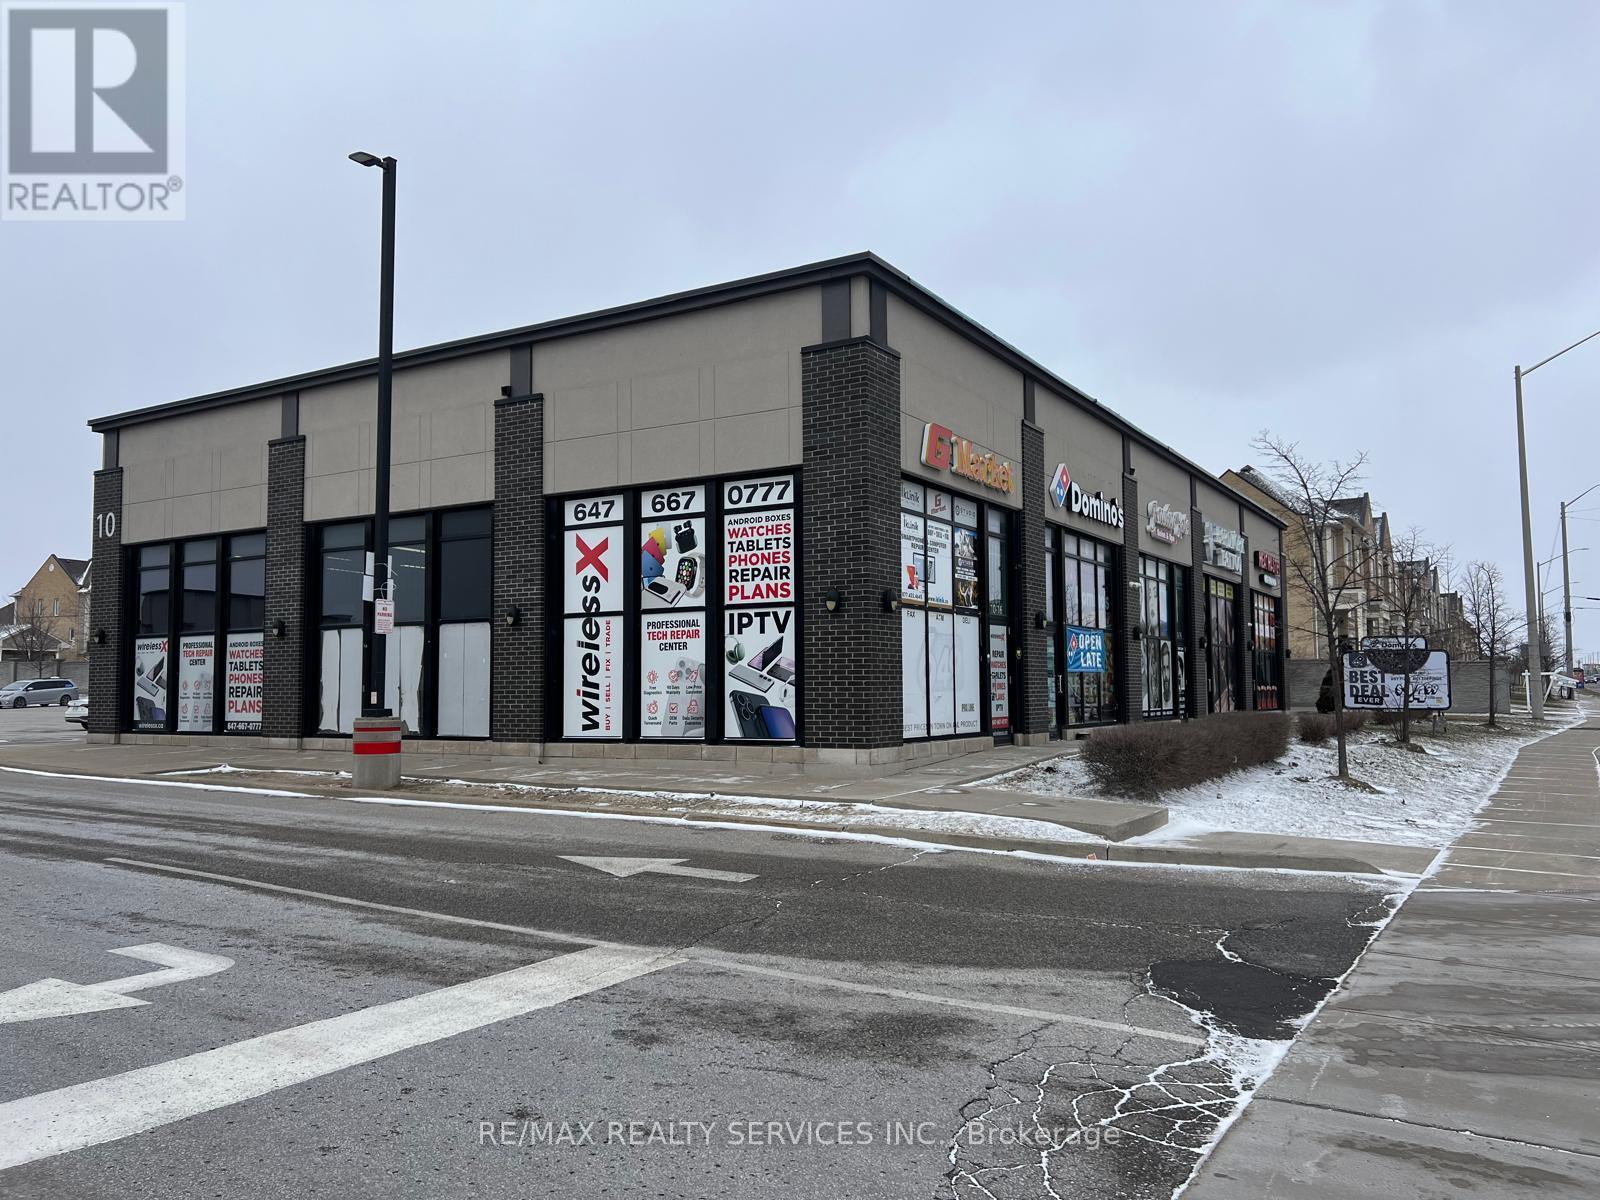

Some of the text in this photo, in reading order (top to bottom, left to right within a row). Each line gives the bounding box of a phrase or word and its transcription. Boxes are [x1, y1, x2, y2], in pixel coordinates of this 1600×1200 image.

[951, 435, 1014, 495] Market
[727, 480, 791, 505] 0777
[651, 490, 696, 513] 667
[1071, 480, 1124, 529] Domino's
[574, 500, 615, 521] 647
[96, 512, 116, 538] 10
[727, 513, 791, 526] ANDROID BOXES
[727, 523, 792, 539] WATCHES
[727, 536, 791, 553] TABLETS
[728, 550, 791, 567] PHONES
[728, 565, 790, 583] REPAIR
[728, 582, 791, 601] PLANS
[647, 619, 701, 630] PROFESSIONAL
[728, 610, 792, 635] IPTV
[647, 629, 700, 641] TECH REPAIR
[1078, 632, 1102, 651] OPEN
[137, 640, 168, 653] wirelessX
[182, 641, 214, 649] PROFESSIONAL
[659, 641, 688, 651] CENTER
[182, 649, 213, 658] TECH REPAIR
[229, 649, 264, 660] WATCHES
[1080, 651, 1102, 668] LATE
[189, 658, 206, 666] CENTER
[228, 660, 264, 671] TABLETS
[228, 673, 263, 684] PHONES
[1349, 670, 1386, 683] BEST
[228, 685, 262, 698] REPAIR
[1350, 684, 1390, 697] DEAL
[228, 700, 262, 713] PLANS
[1358, 696, 1381, 704] EVER
